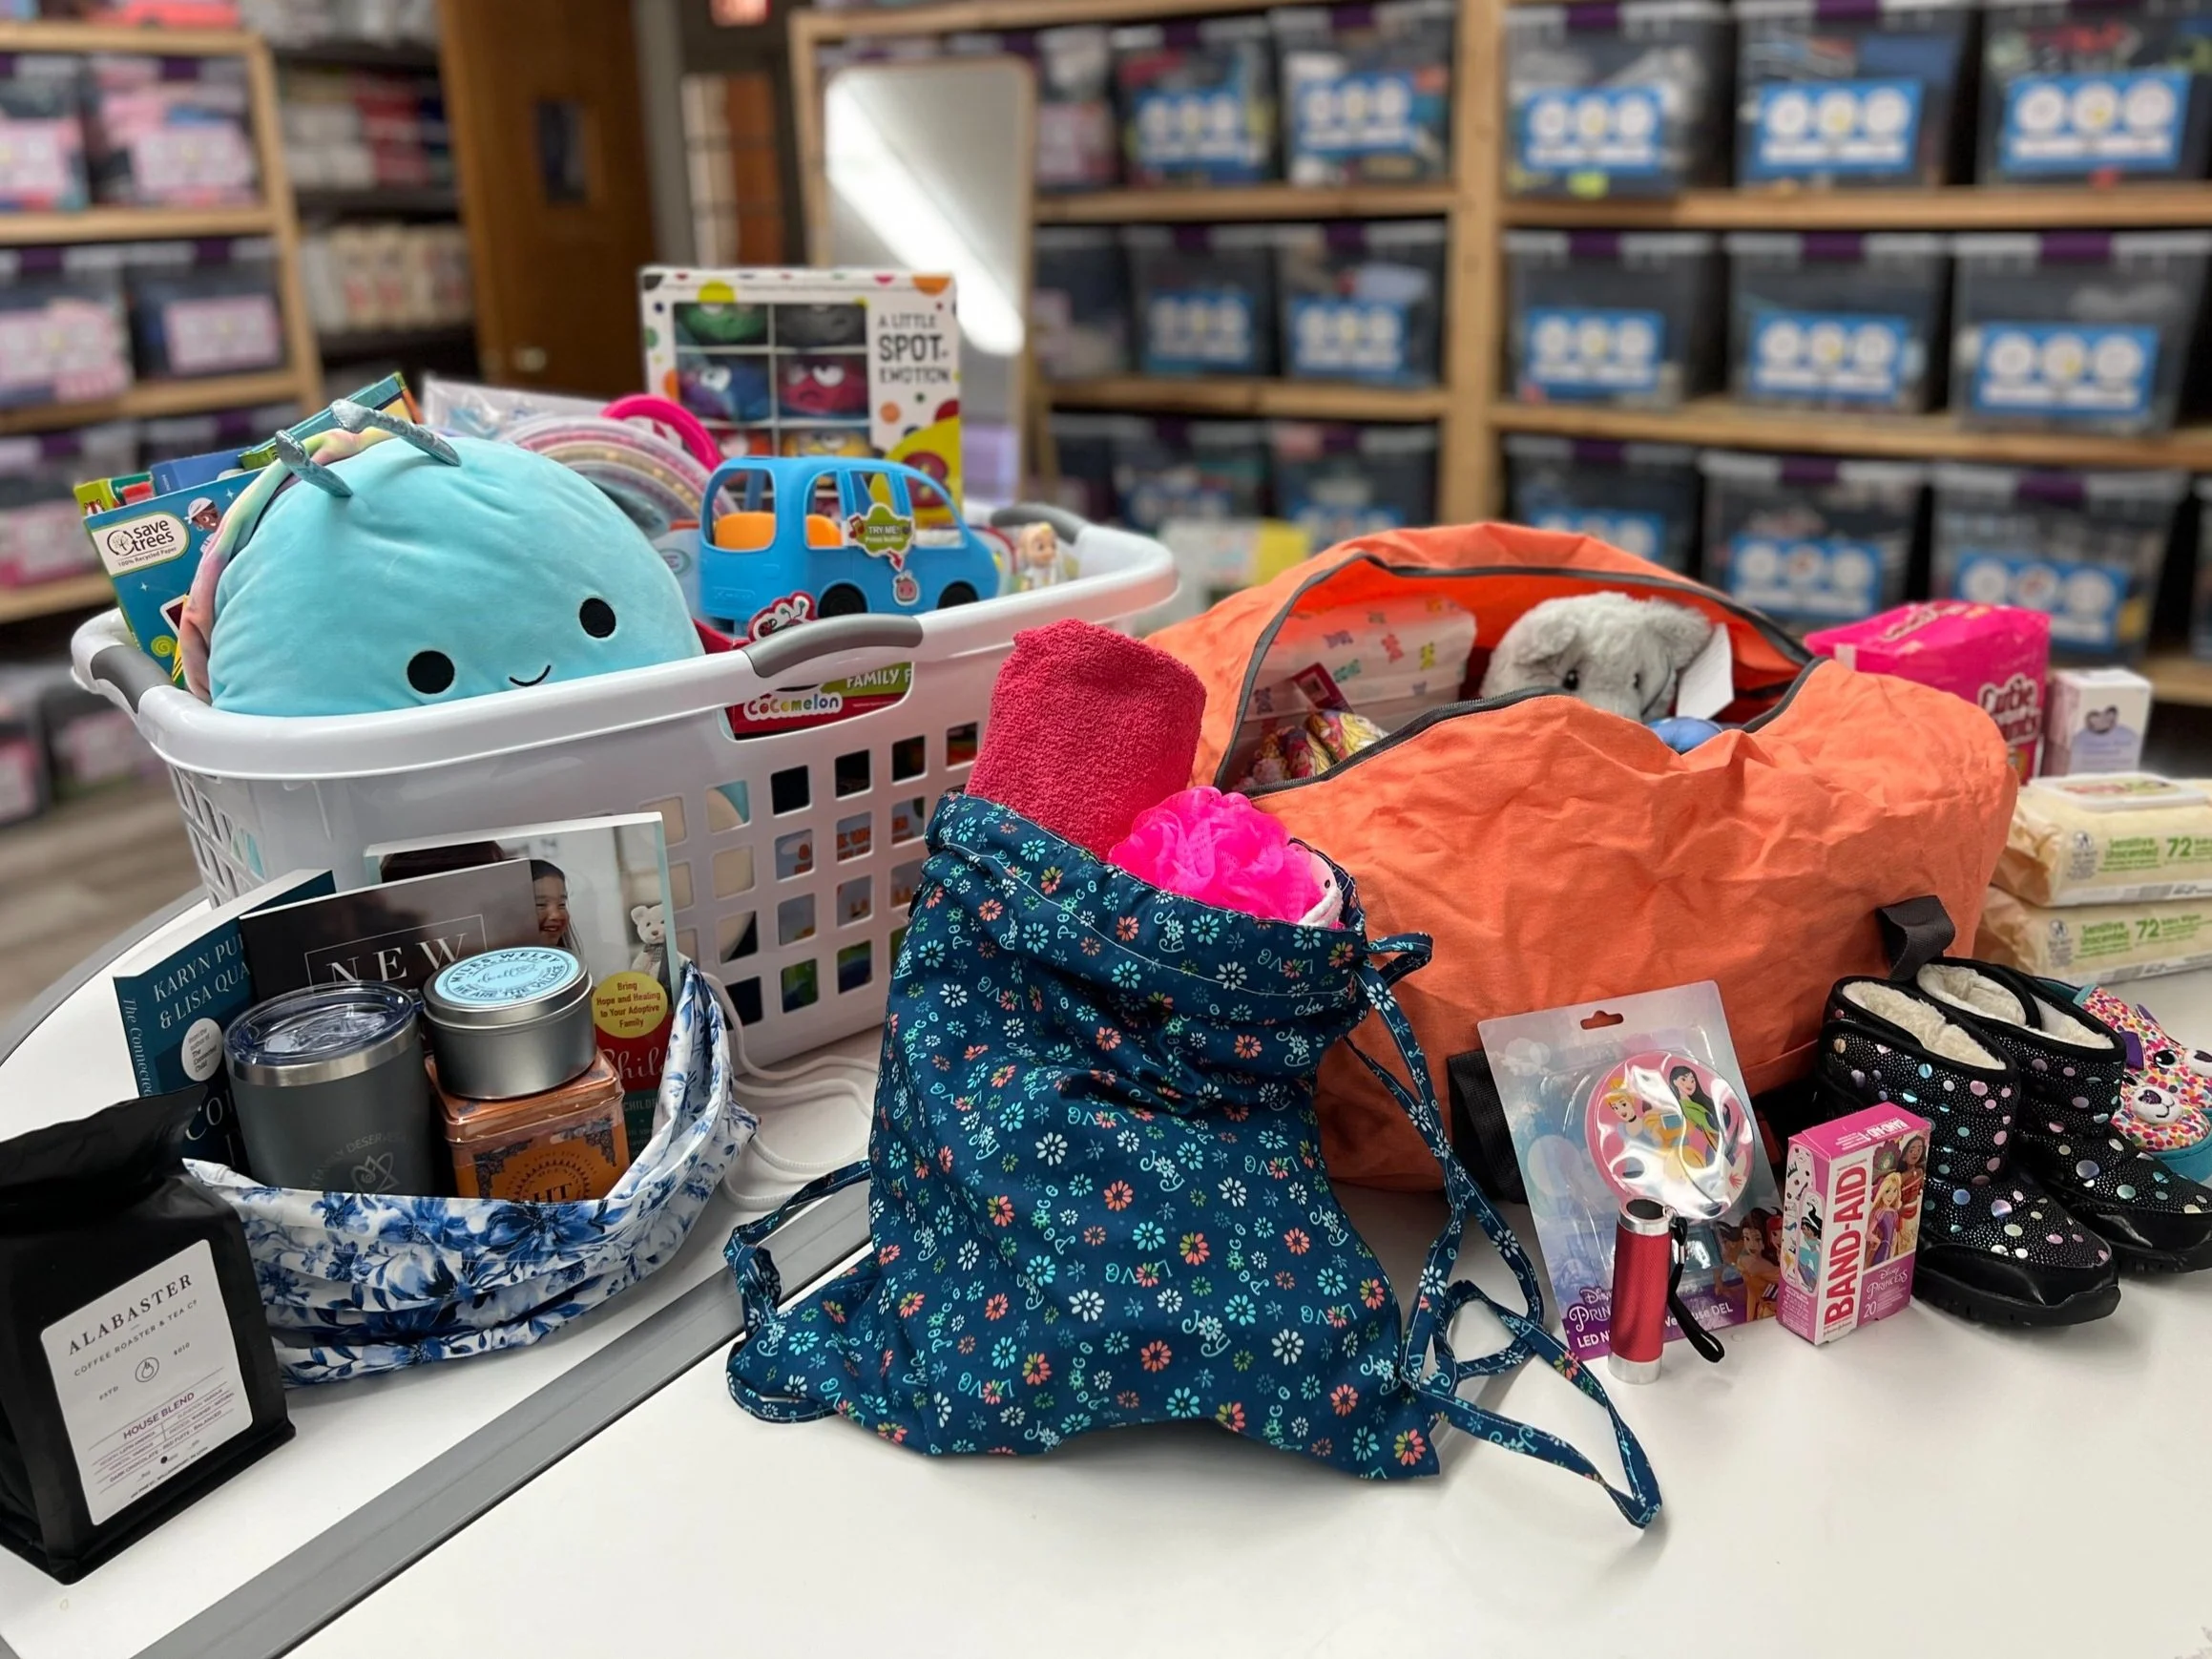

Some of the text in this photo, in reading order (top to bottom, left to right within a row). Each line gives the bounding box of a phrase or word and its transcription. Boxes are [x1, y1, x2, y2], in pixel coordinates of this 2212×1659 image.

[891, 313, 936, 329] LITTLE
[879, 333, 943, 362] SPOT
[880, 366, 950, 385] EMOTION
[134, 519, 170, 539] save
[868, 526, 884, 535] TRY
[132, 530, 175, 552] trees
[117, 546, 177, 567] 100% Recycled Paper
[846, 668, 900, 689] FAMILY
[2166, 836, 2193, 857] 72
[2135, 918, 2160, 939] 72
[326, 933, 468, 983] NEW
[450, 958, 491, 983] MILES
[500, 952, 561, 963] WELBY
[153, 953, 212, 1002] KARYN
[470, 990, 497, 998] ARE
[503, 987, 528, 998] THE
[531, 965, 565, 989] VILLAGE
[617, 981, 638, 992] Bring
[159, 1008, 173, 1030] &
[175, 983, 212, 1021] LISA
[596, 992, 661, 1006] Hope and Healing
[123, 998, 137, 1023] The
[600, 1004, 659, 1018] to Your Adoptive
[618, 1018, 644, 1029] Family
[1867, 1119, 1909, 1141] BAND-AID
[1825, 1166, 1868, 1326] BAND-AID
[1879, 1266, 1900, 1280] Disney
[1867, 1269, 1909, 1300] PRINCESS
[68, 1272, 193, 1356] ALABASTER
[1711, 1302, 1734, 1316] DEL
[1864, 1300, 1877, 1318] 20
[73, 1349, 112, 1376] COFFEE
[115, 1324, 157, 1354] ROASTER
[168, 1309, 185, 1322] TEA
[1576, 1334, 1598, 1349] LED
[123, 1392, 195, 1440] HOUSE BLEND
[194, 1410, 222, 1431] BALANCED
